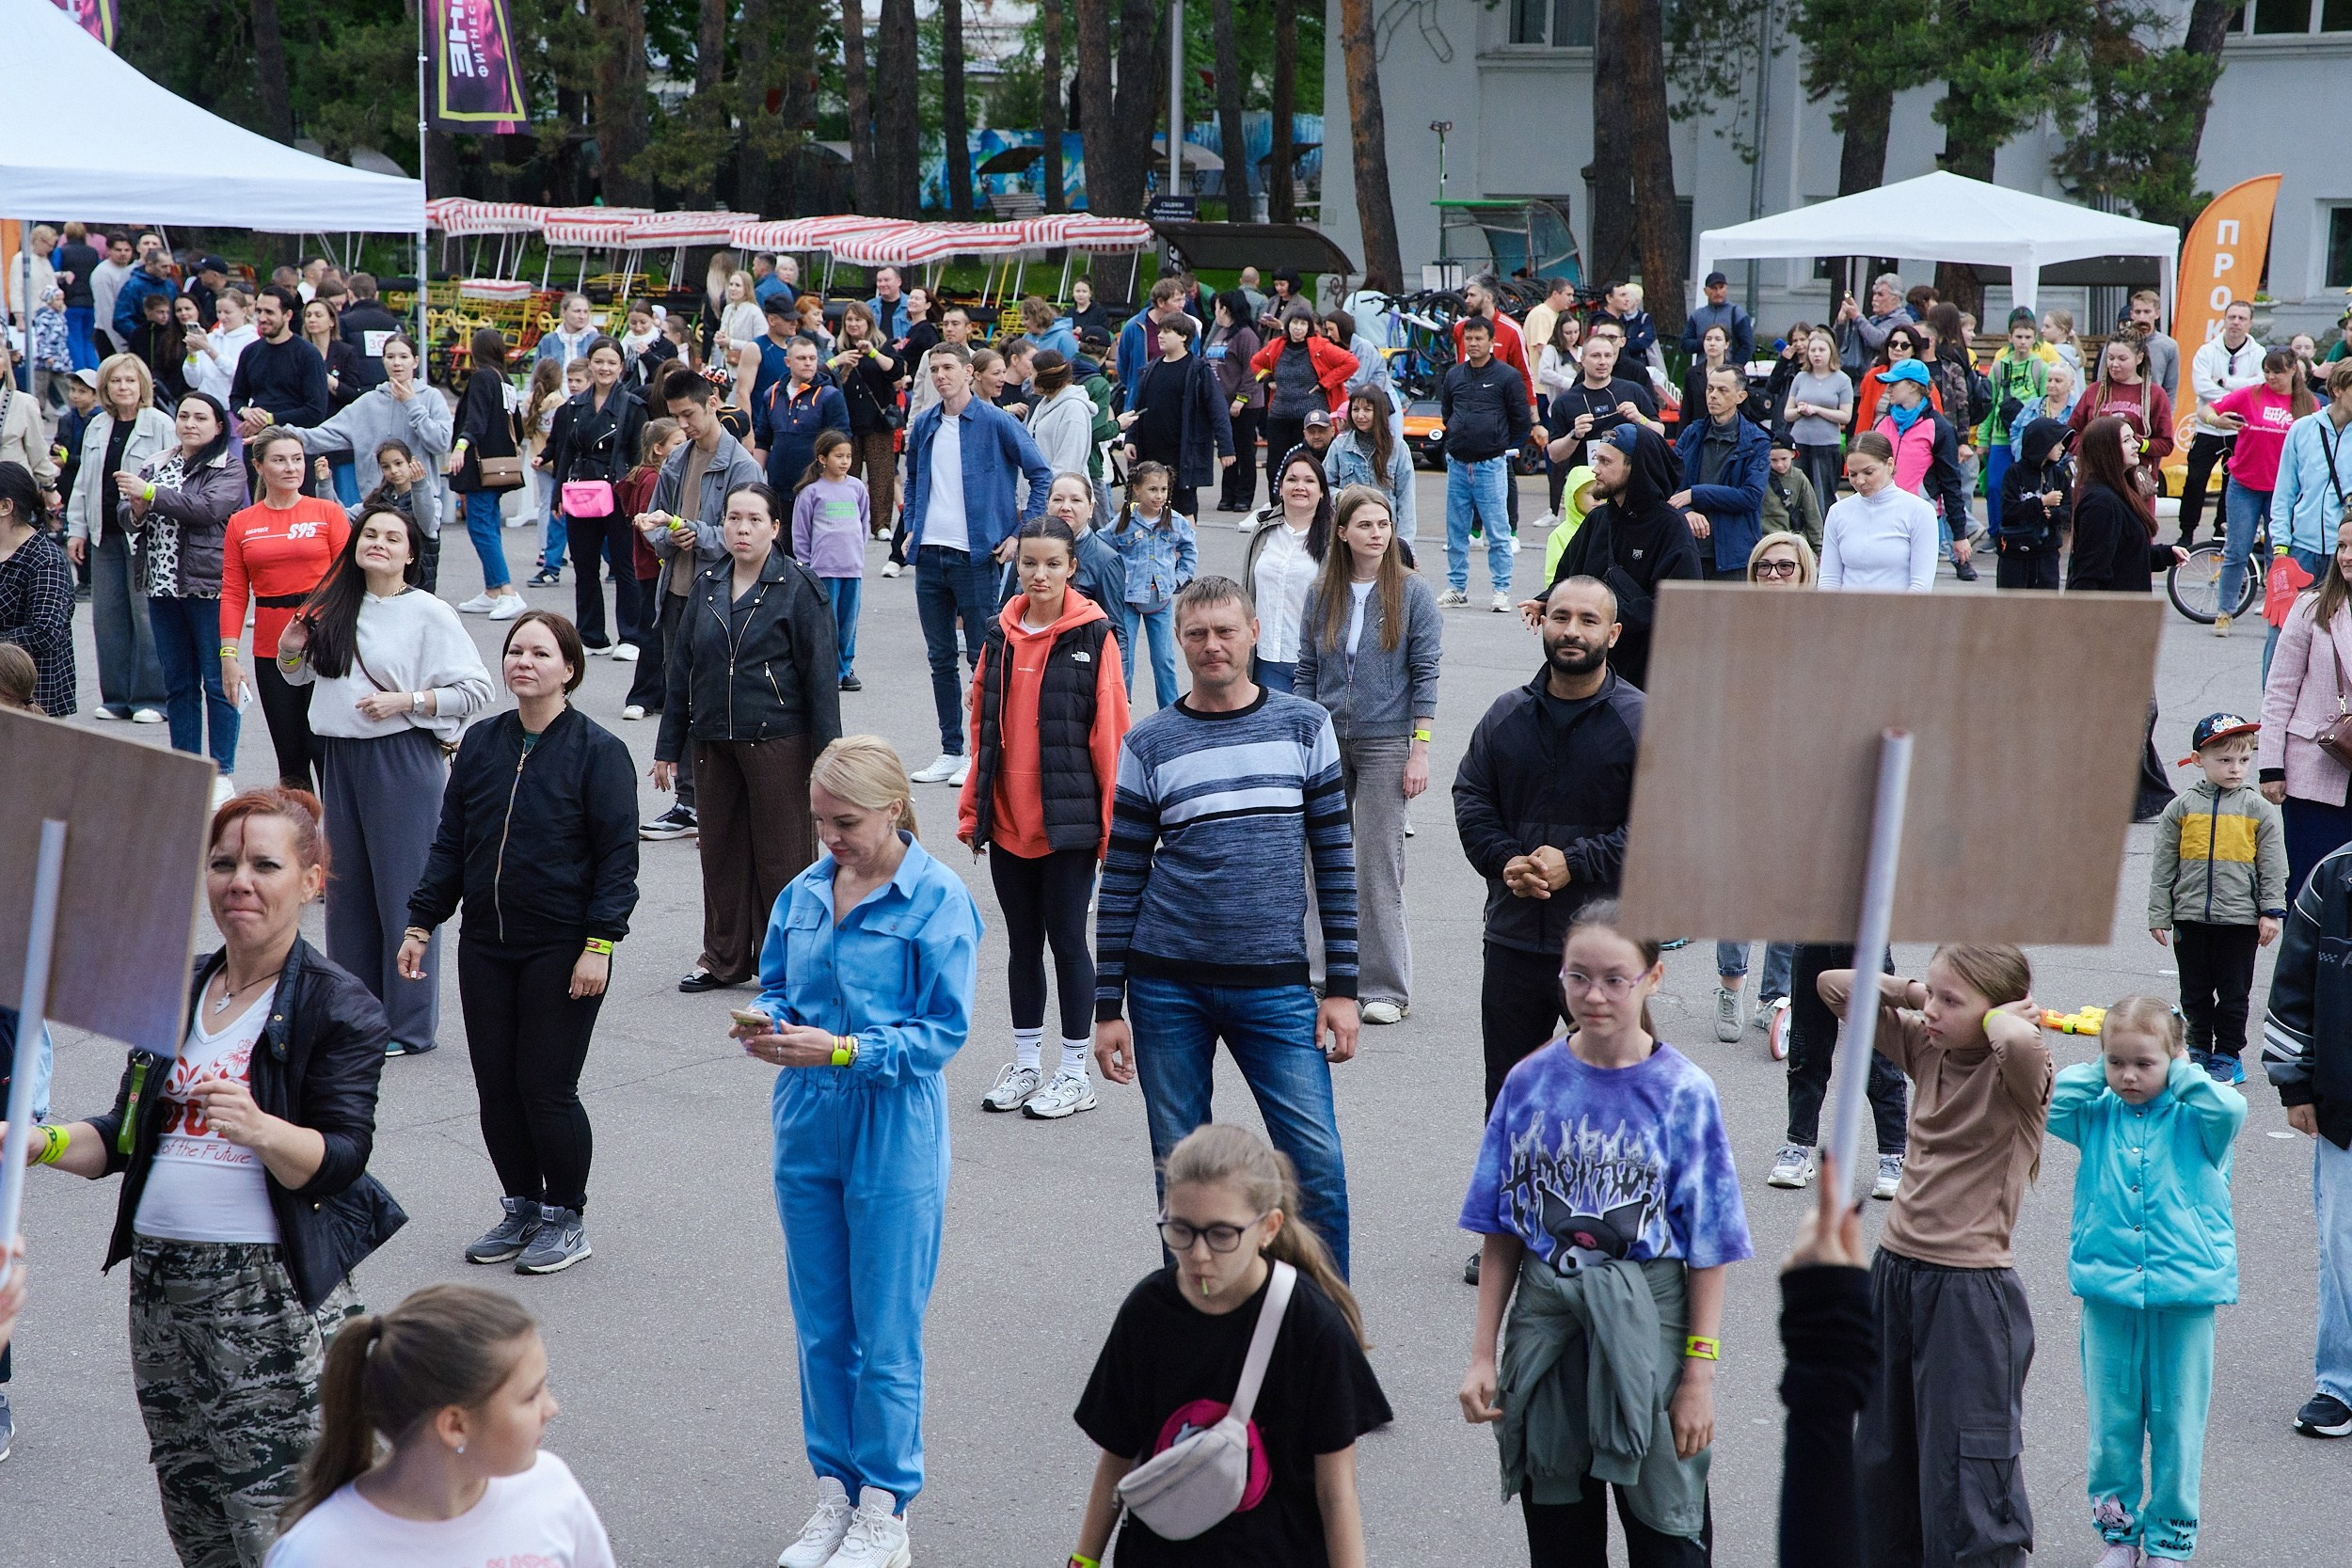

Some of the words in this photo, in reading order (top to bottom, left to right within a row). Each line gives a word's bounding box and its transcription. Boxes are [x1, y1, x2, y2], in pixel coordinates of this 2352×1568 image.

[449, 0, 474, 77] ЭН
[287, 522, 319, 540] S95
[178, 1140, 199, 1157] the
[200, 1144, 252, 1164] Future
[2169, 1518, 2198, 1528] WANT
